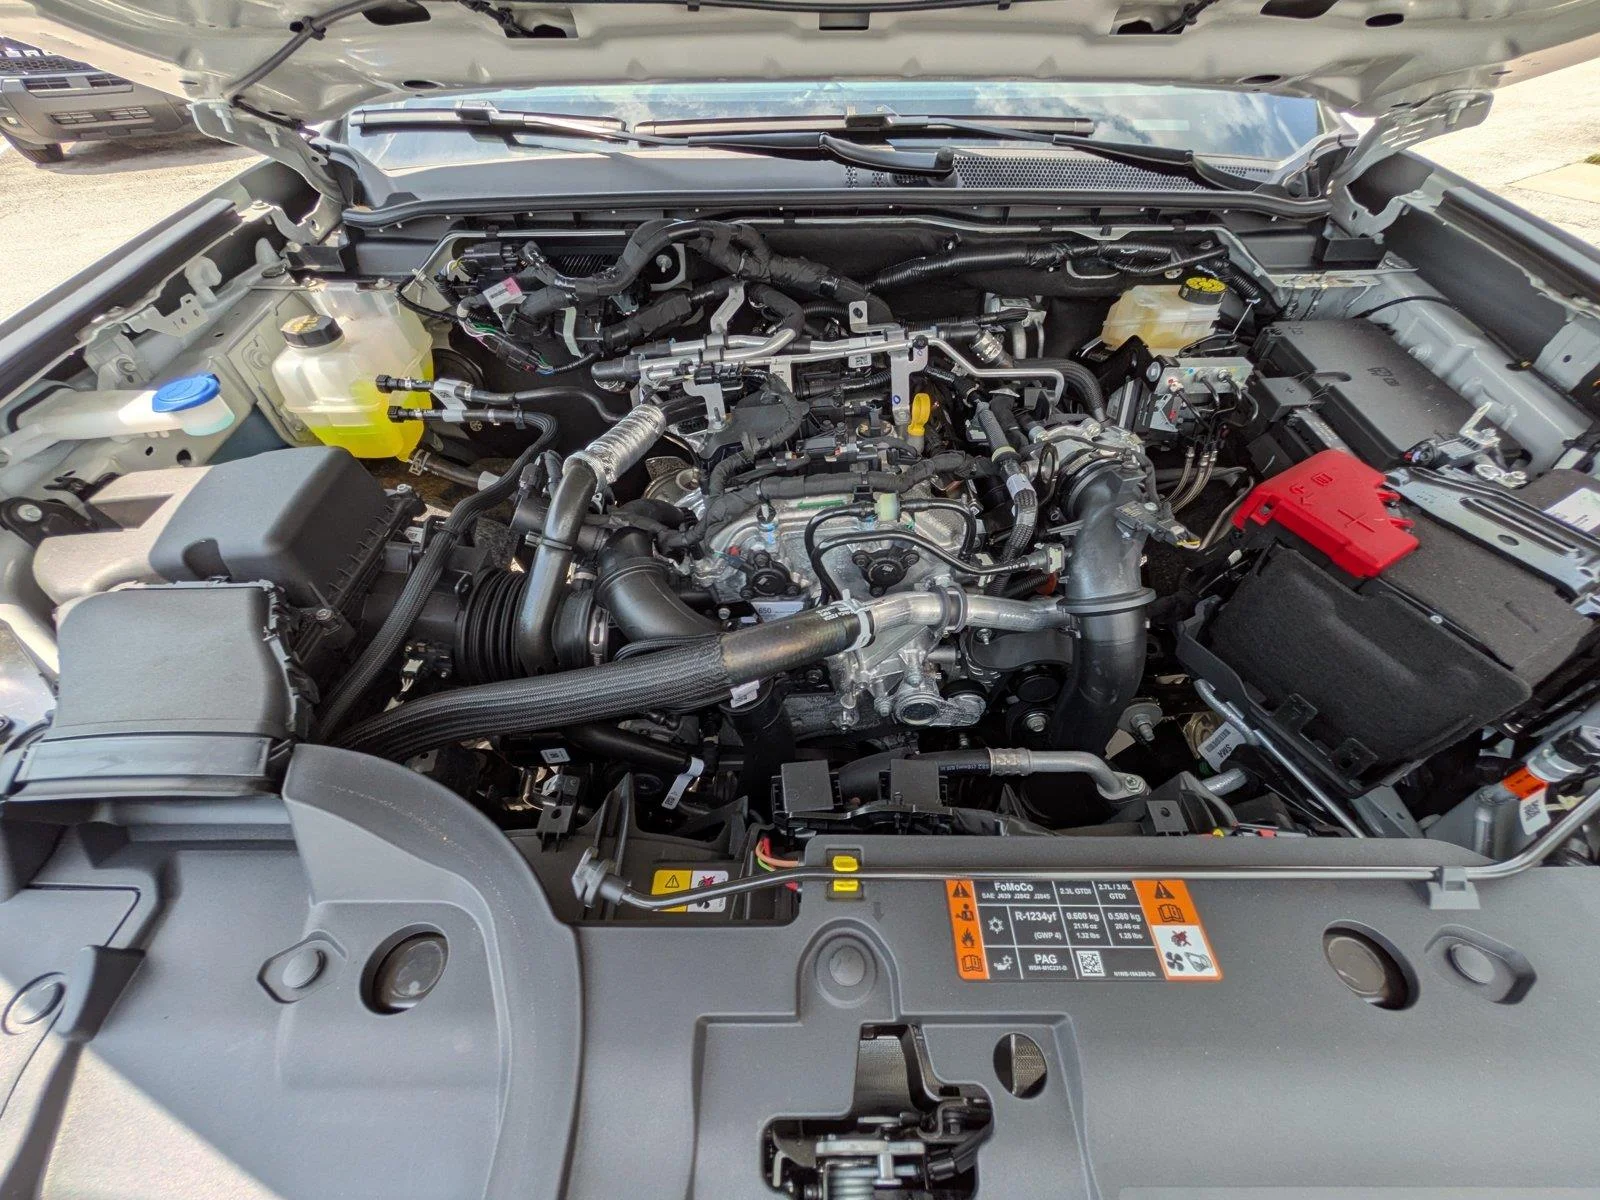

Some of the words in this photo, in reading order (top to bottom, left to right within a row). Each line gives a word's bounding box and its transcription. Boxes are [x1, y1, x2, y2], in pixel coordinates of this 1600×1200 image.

[994, 882, 1034, 892] FoMoCo
[1014, 912, 1057, 923] R-1234yf
[1088, 912, 1100, 922] kg
[1130, 912, 1142, 922] kg
[1034, 932, 1053, 940] (GWP
[1054, 932, 1062, 940] 4)
[1034, 954, 1058, 964] PAG
